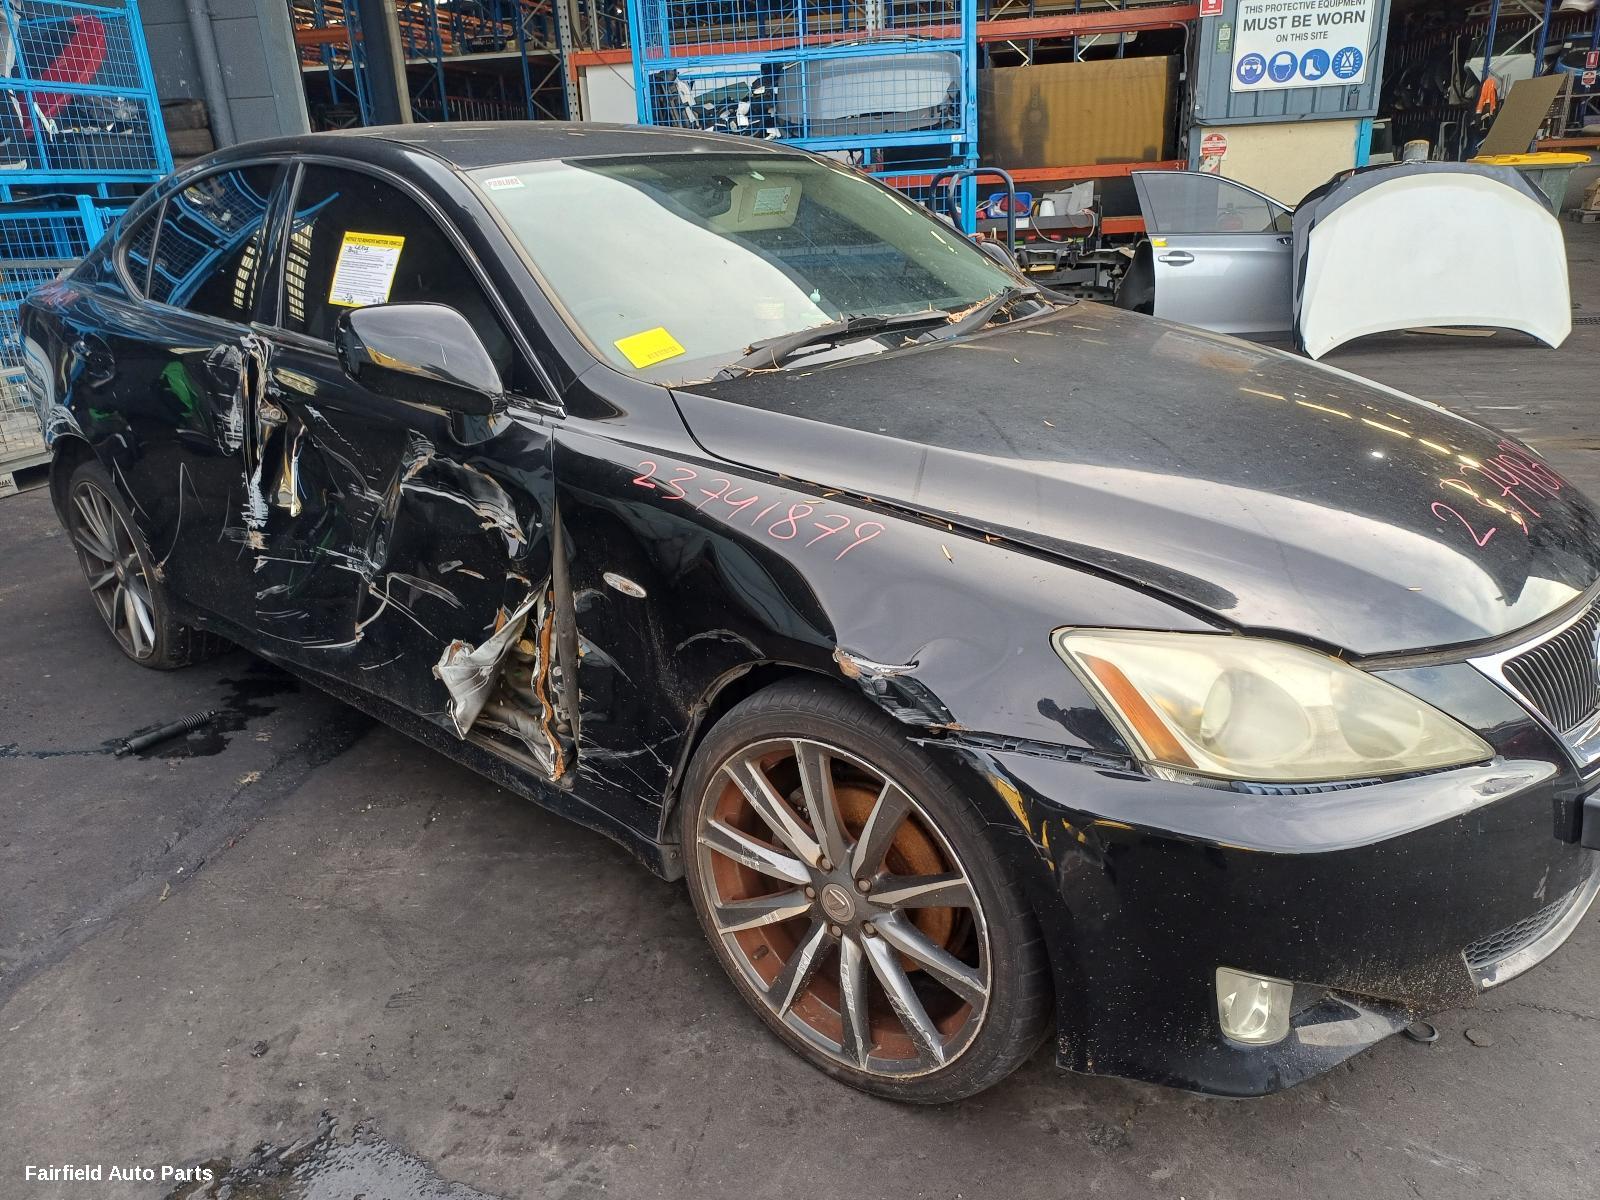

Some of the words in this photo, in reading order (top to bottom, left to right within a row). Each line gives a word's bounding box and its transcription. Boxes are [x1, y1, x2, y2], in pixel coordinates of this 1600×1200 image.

[1245, 5, 1263, 14] THIS
[1265, 1, 1316, 13] PROTECTIVE
[1243, 16, 1288, 32] MUST
[1291, 14, 1312, 28] BE
[1317, 10, 1366, 26] WORN
[1275, 34, 1289, 43] ON
[1290, 32, 1308, 42] THIS
[1310, 31, 1328, 40] SITE
[633, 461, 885, 560] 23741879
